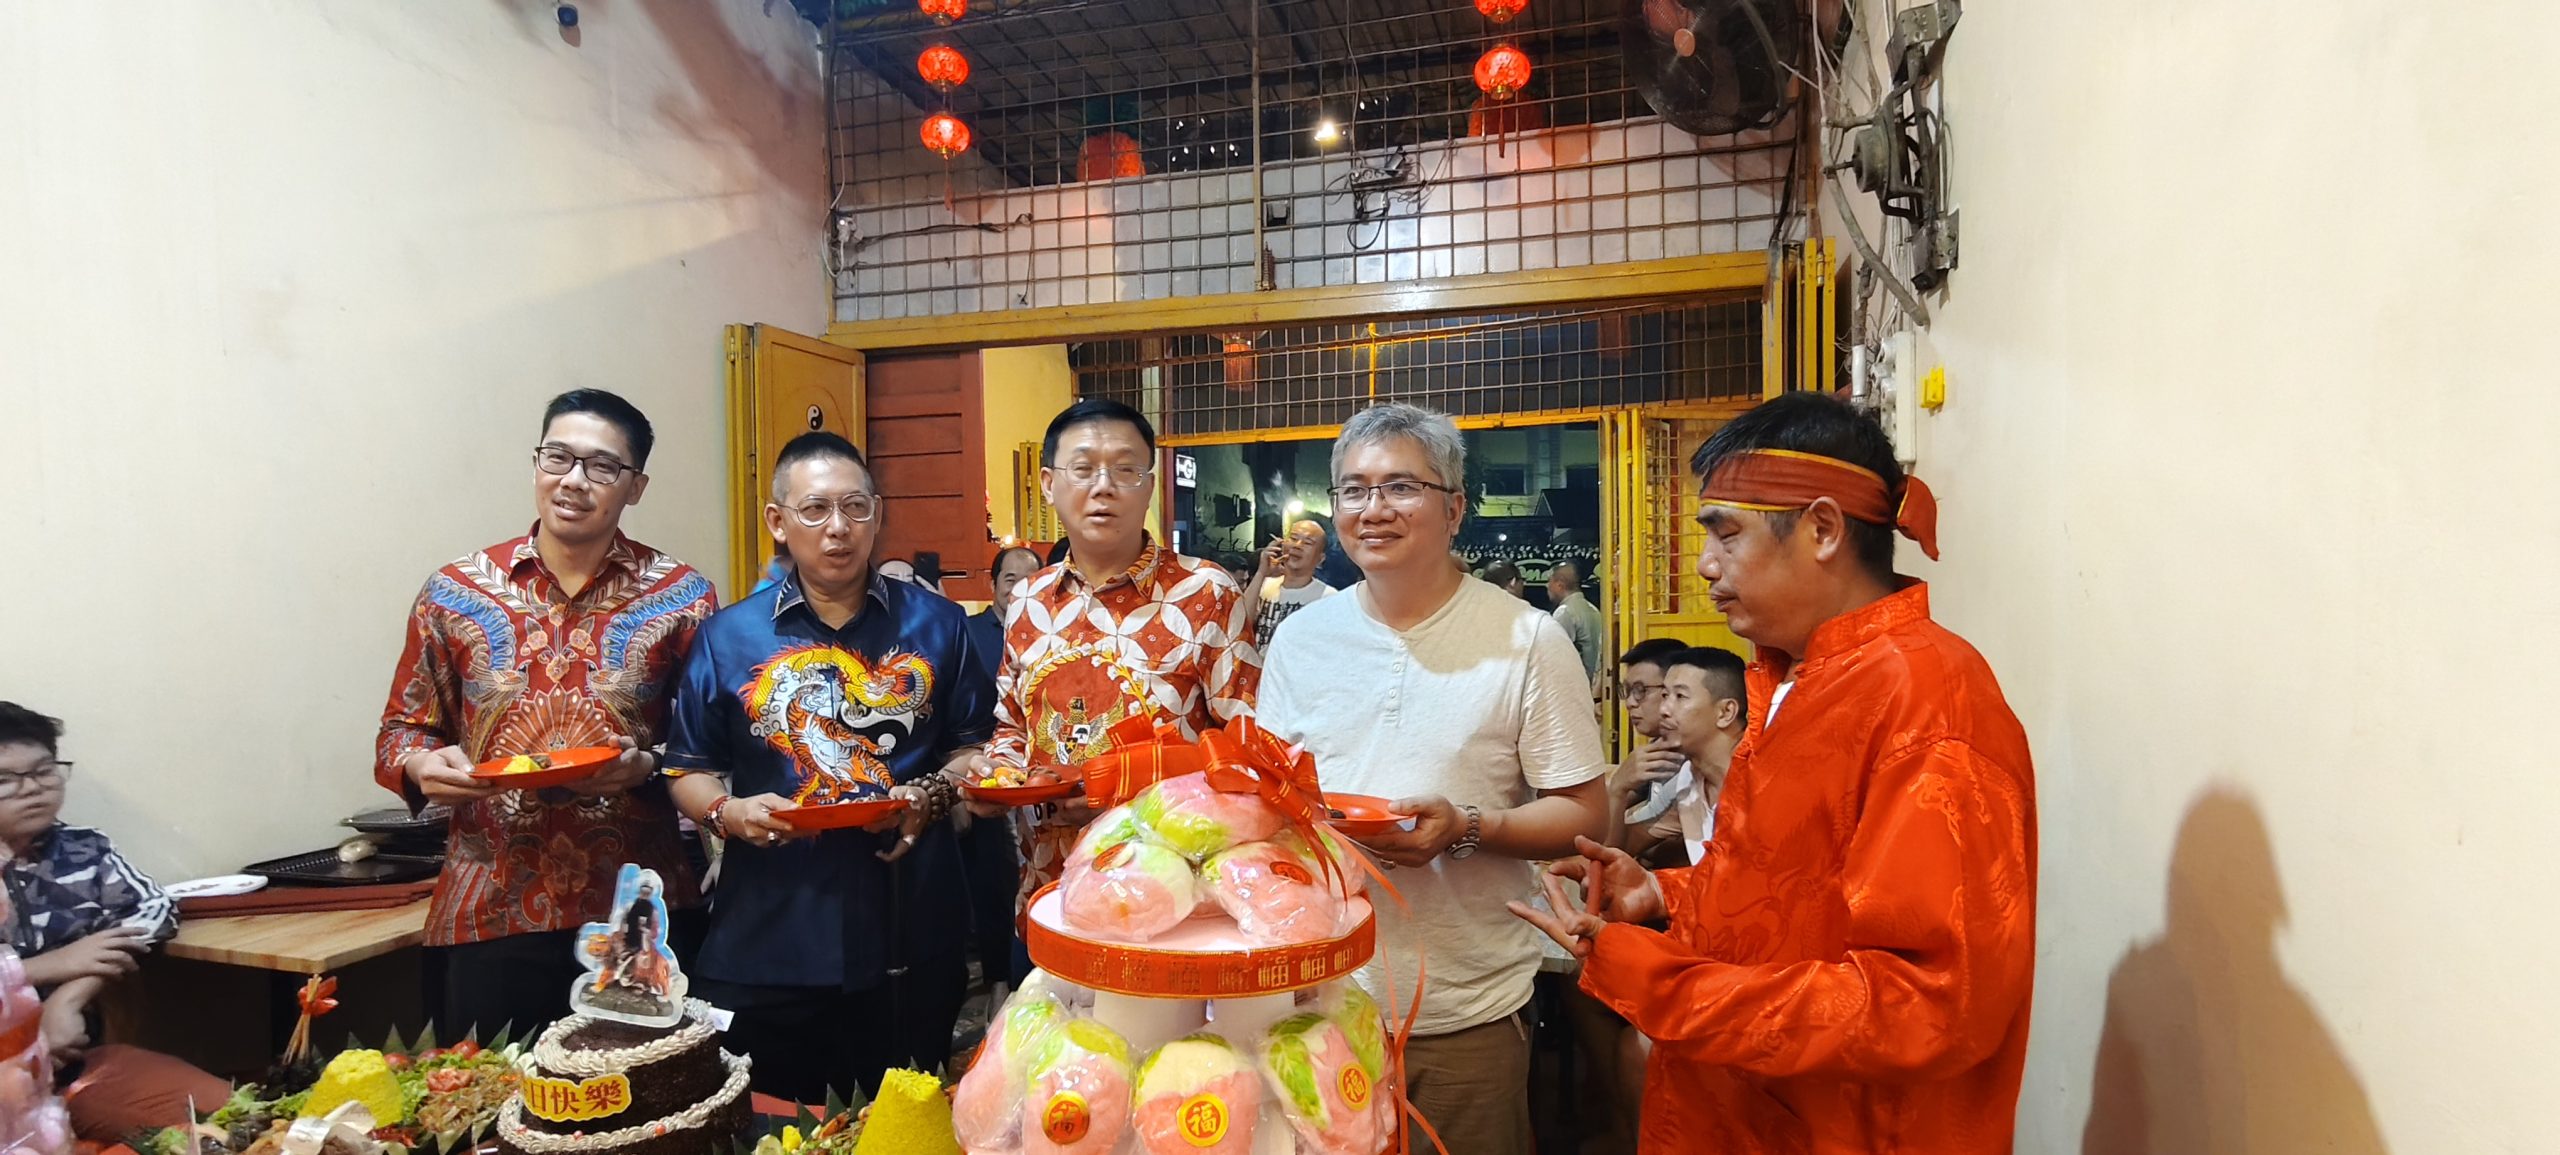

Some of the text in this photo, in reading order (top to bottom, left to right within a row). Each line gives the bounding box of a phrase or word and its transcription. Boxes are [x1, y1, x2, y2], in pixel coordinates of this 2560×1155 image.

[523, 1079, 622, 1115] 日快樂
[1186, 1102, 1217, 1136] 福
